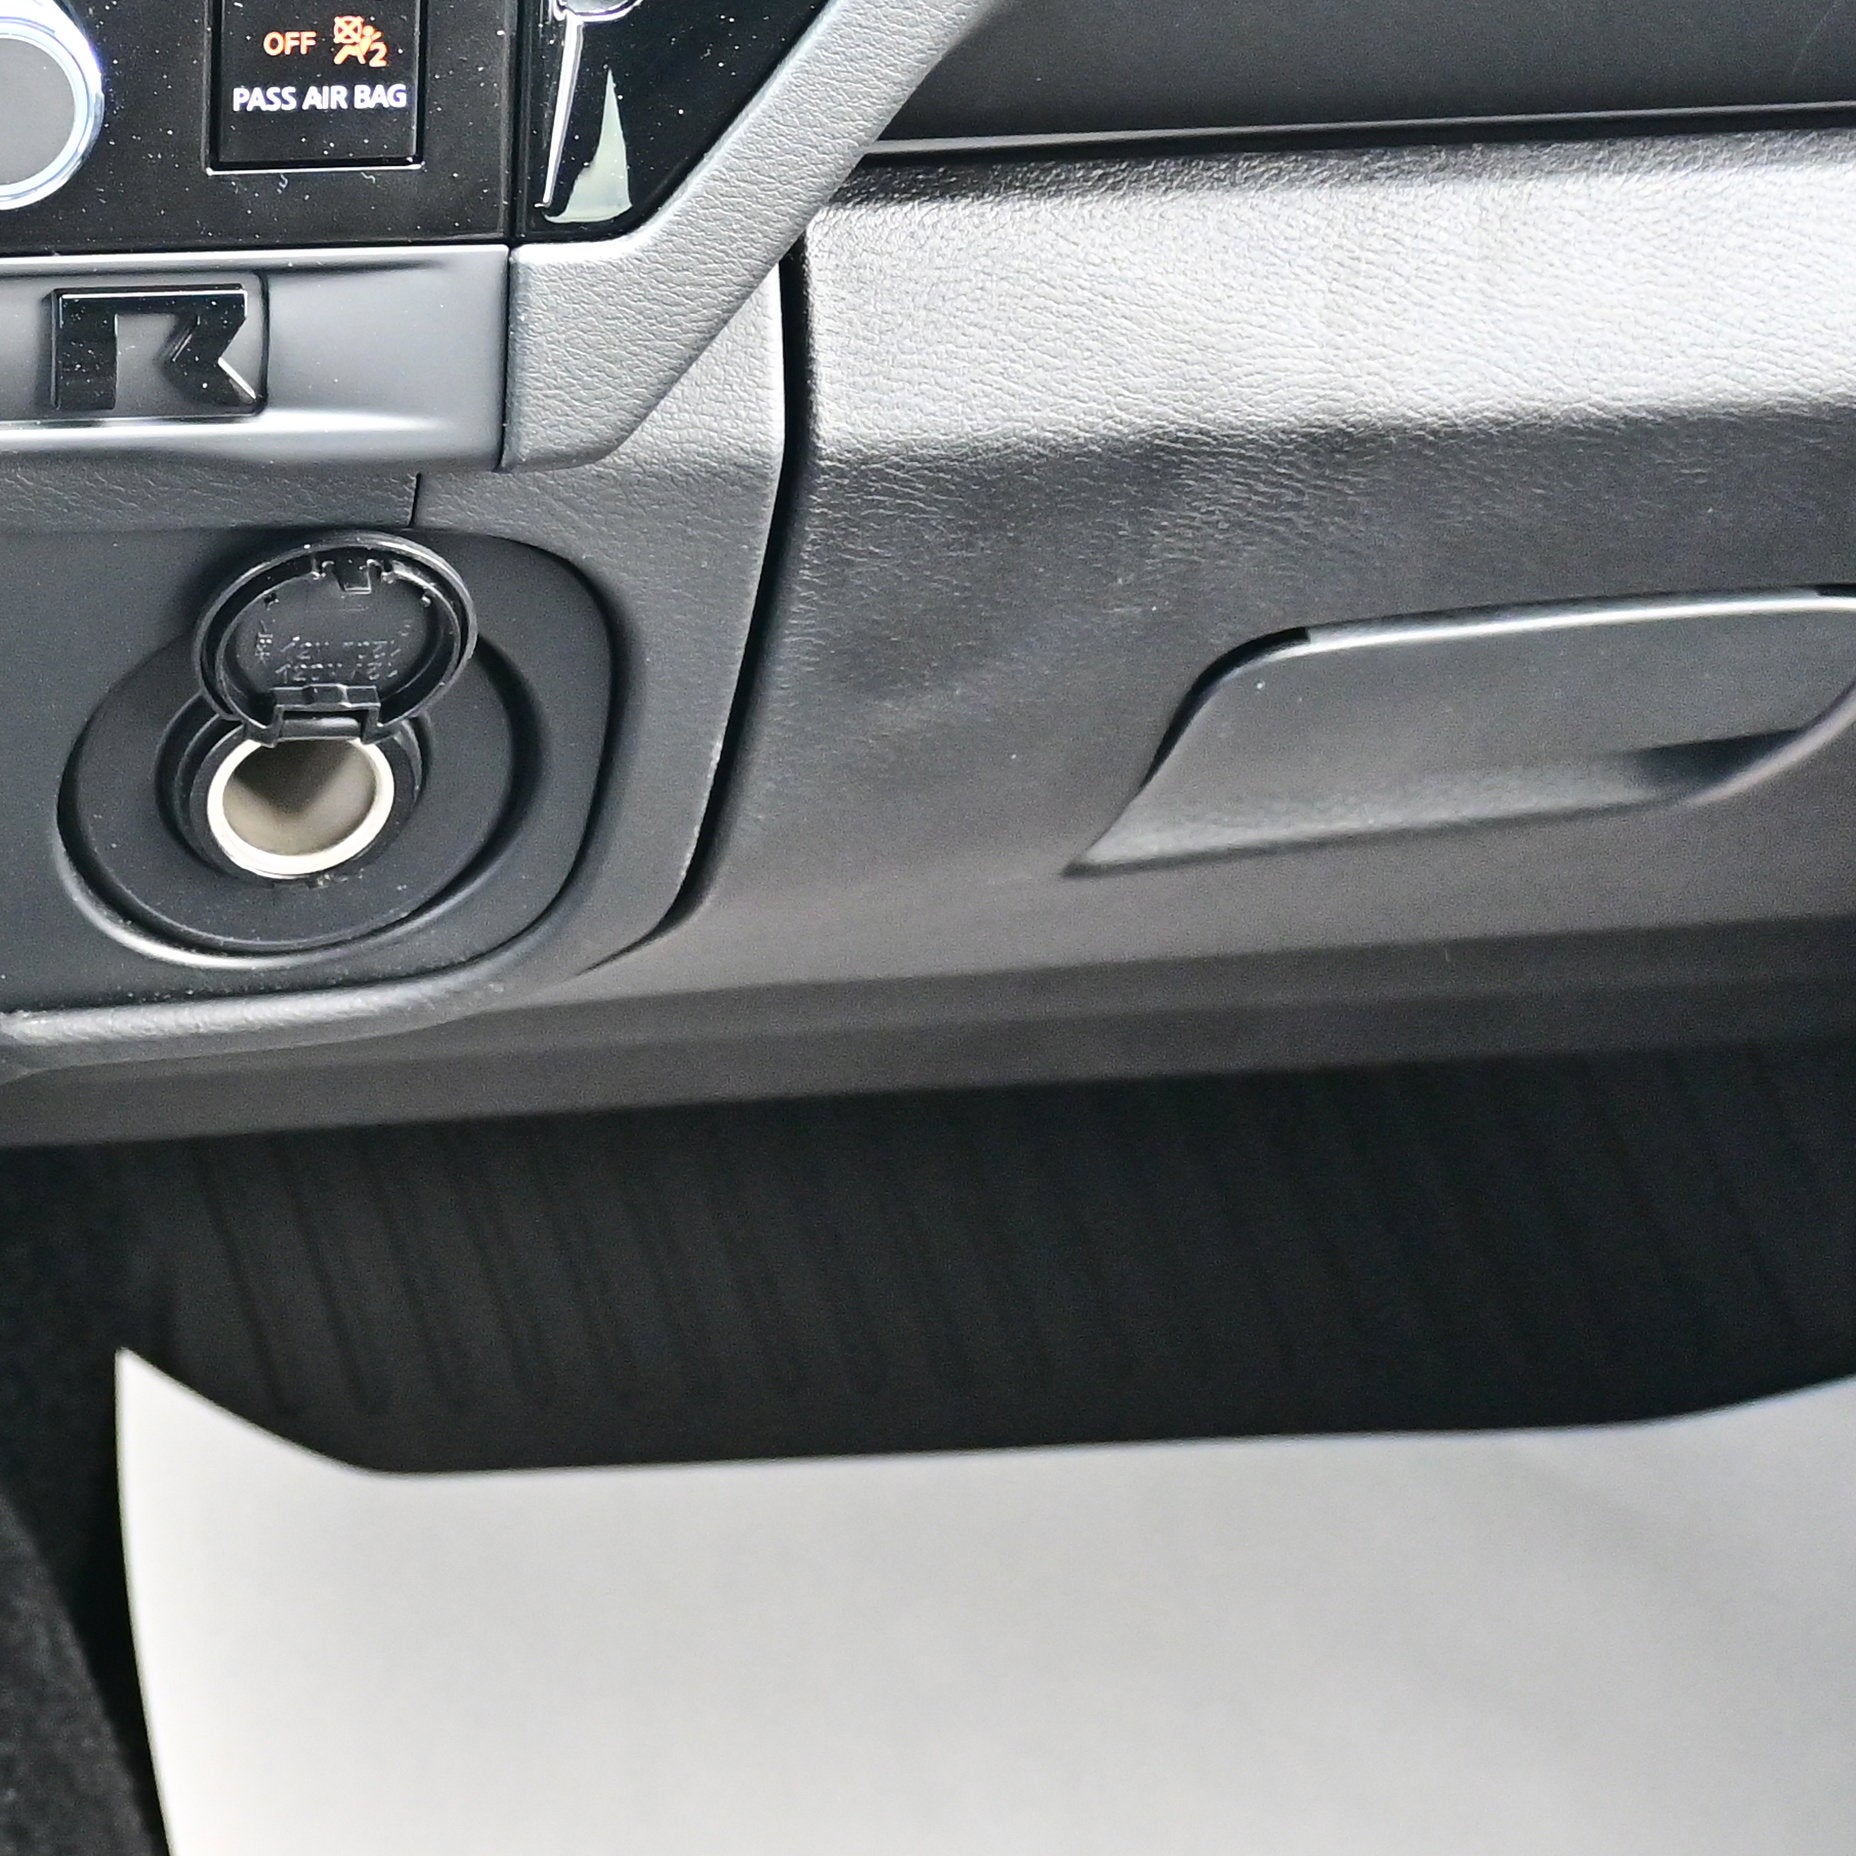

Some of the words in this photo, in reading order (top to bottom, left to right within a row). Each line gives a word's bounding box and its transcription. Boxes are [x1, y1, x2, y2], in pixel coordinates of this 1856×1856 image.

[263, 30, 315, 57] OFF
[232, 86, 297, 113] PASS
[302, 85, 347, 110] AIR
[353, 83, 407, 109] BAG
